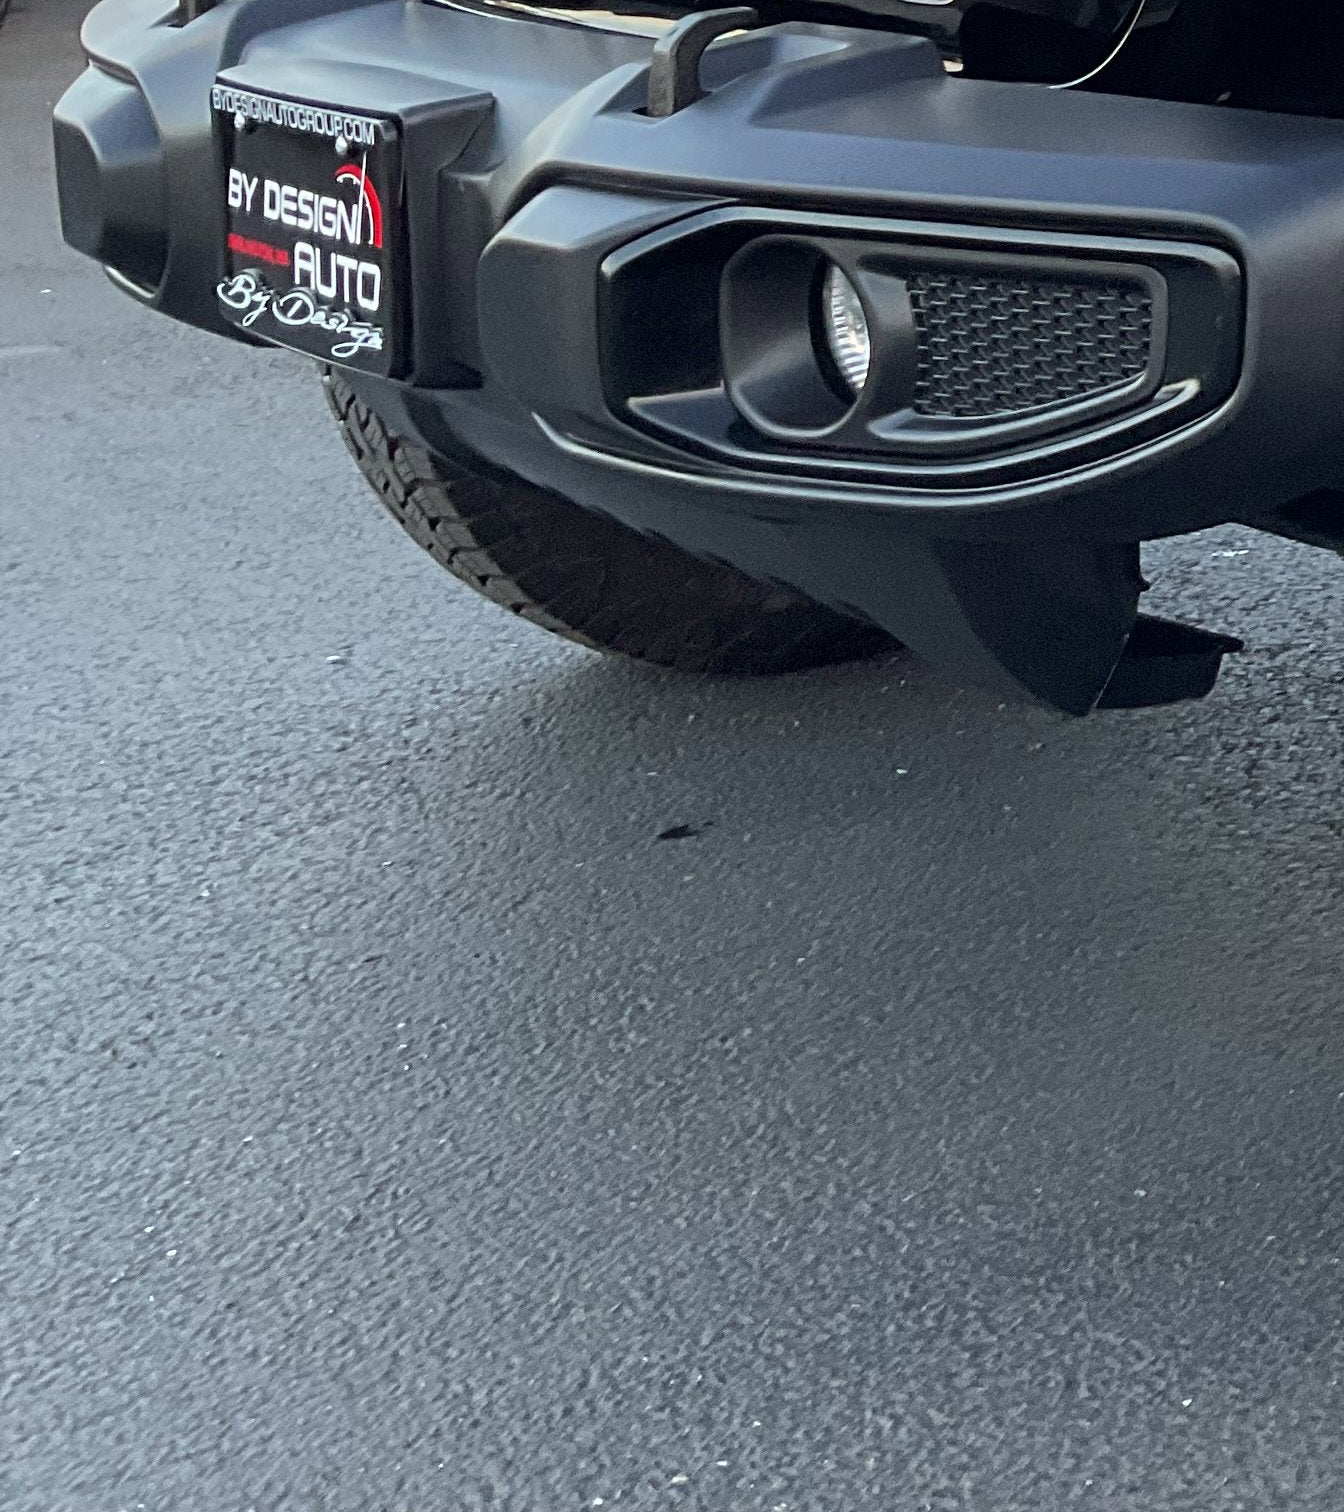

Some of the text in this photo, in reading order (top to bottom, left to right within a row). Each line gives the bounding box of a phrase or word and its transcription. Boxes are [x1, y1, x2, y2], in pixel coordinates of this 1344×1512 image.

[211, 88, 376, 145] BYDESIGNAUTOGROUP.COM
[228, 168, 359, 245] BY DESIGN
[217, 273, 272, 327] By
[294, 241, 381, 312] AUTO
